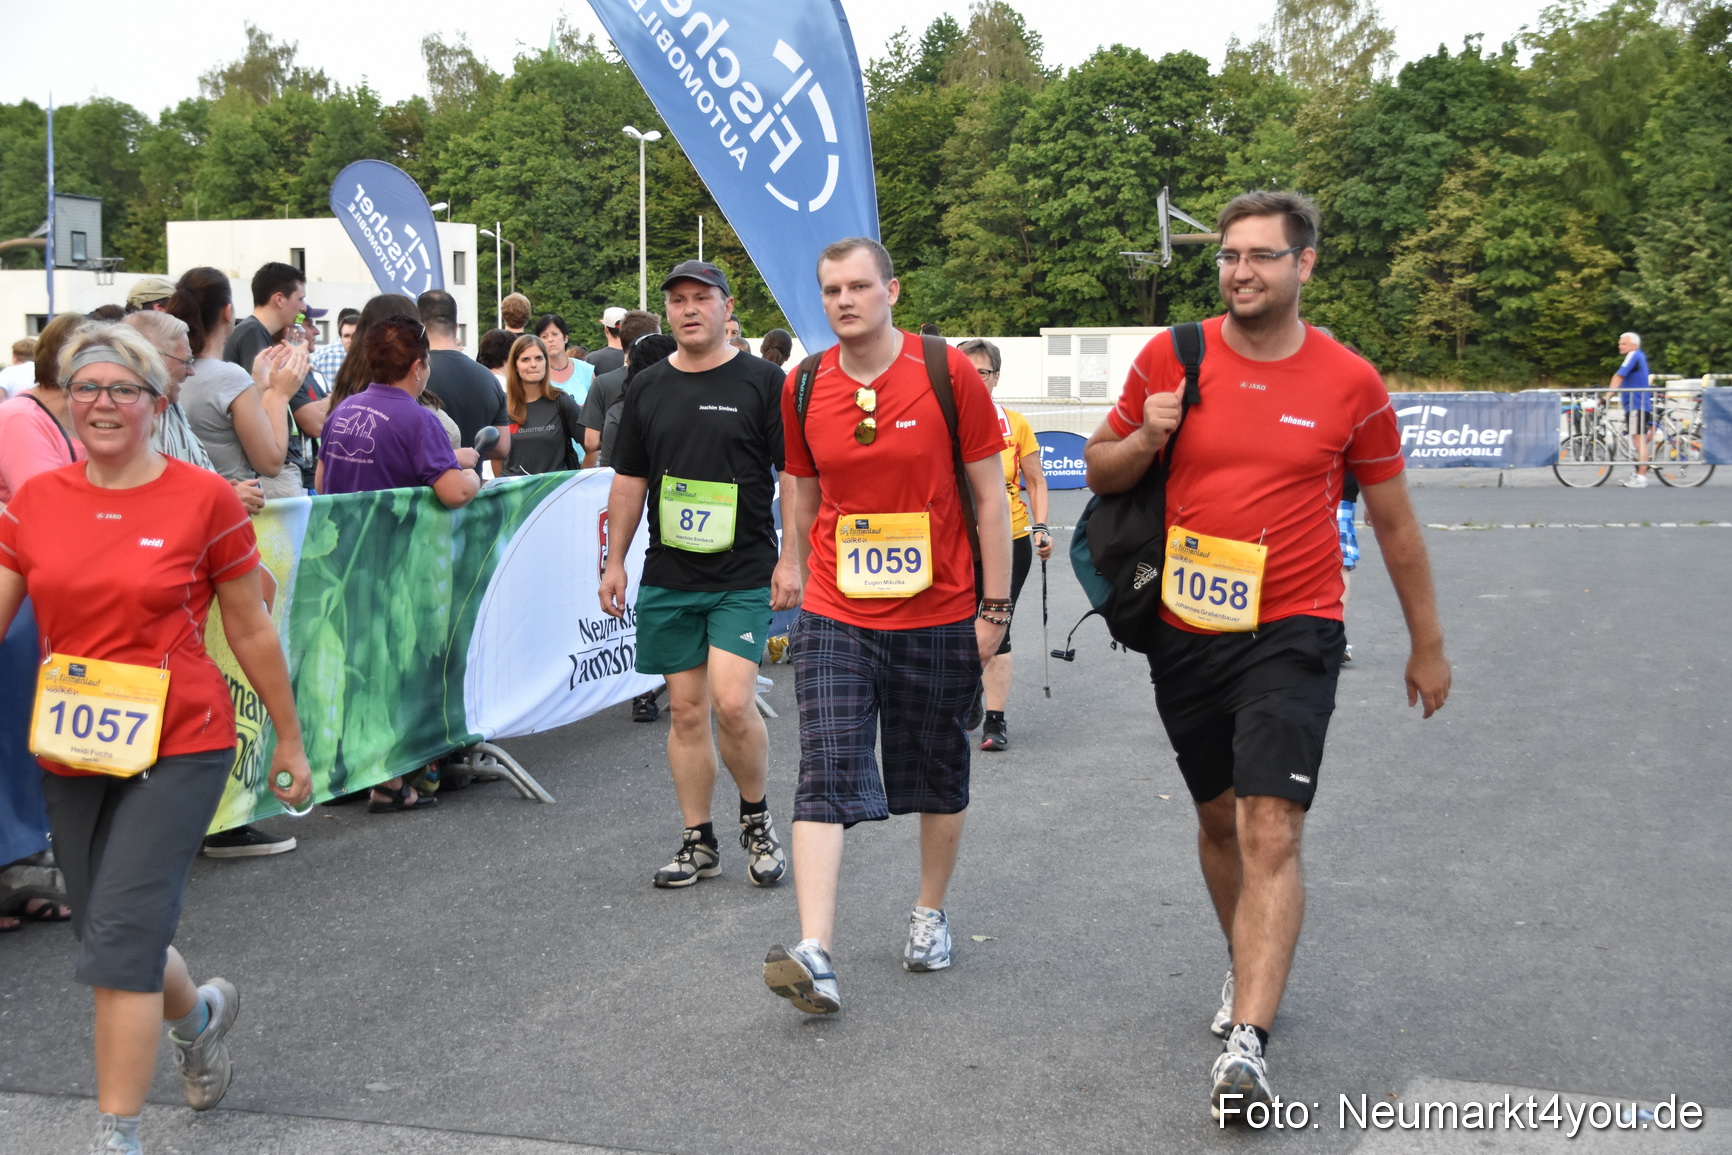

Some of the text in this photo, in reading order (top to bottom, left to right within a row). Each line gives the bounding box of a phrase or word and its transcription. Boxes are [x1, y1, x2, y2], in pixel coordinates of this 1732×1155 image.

[1248, 383, 1266, 391] JAKO
[896, 419, 916, 429] Eugen
[1279, 414, 1316, 428] Johannes
[518, 424, 556, 434] duerrer.de
[1400, 424, 1513, 445] Fischer
[1409, 447, 1503, 457] AUTOMOBILE
[1043, 469, 1088, 477] UTOMOBILE
[680, 508, 711, 532] 87
[140, 538, 164, 547] Heidi
[848, 547, 922, 574] 1059
[1133, 567, 1157, 589] adidas
[1173, 566, 1248, 610] 1058
[1174, 601, 1200, 614] Johannes
[1200, 608, 1240, 623] Grabenbauer
[59, 673, 102, 687] firmenlauf
[50, 700, 149, 746] 1057
[70, 745, 113, 758] Heidi Fuchs
